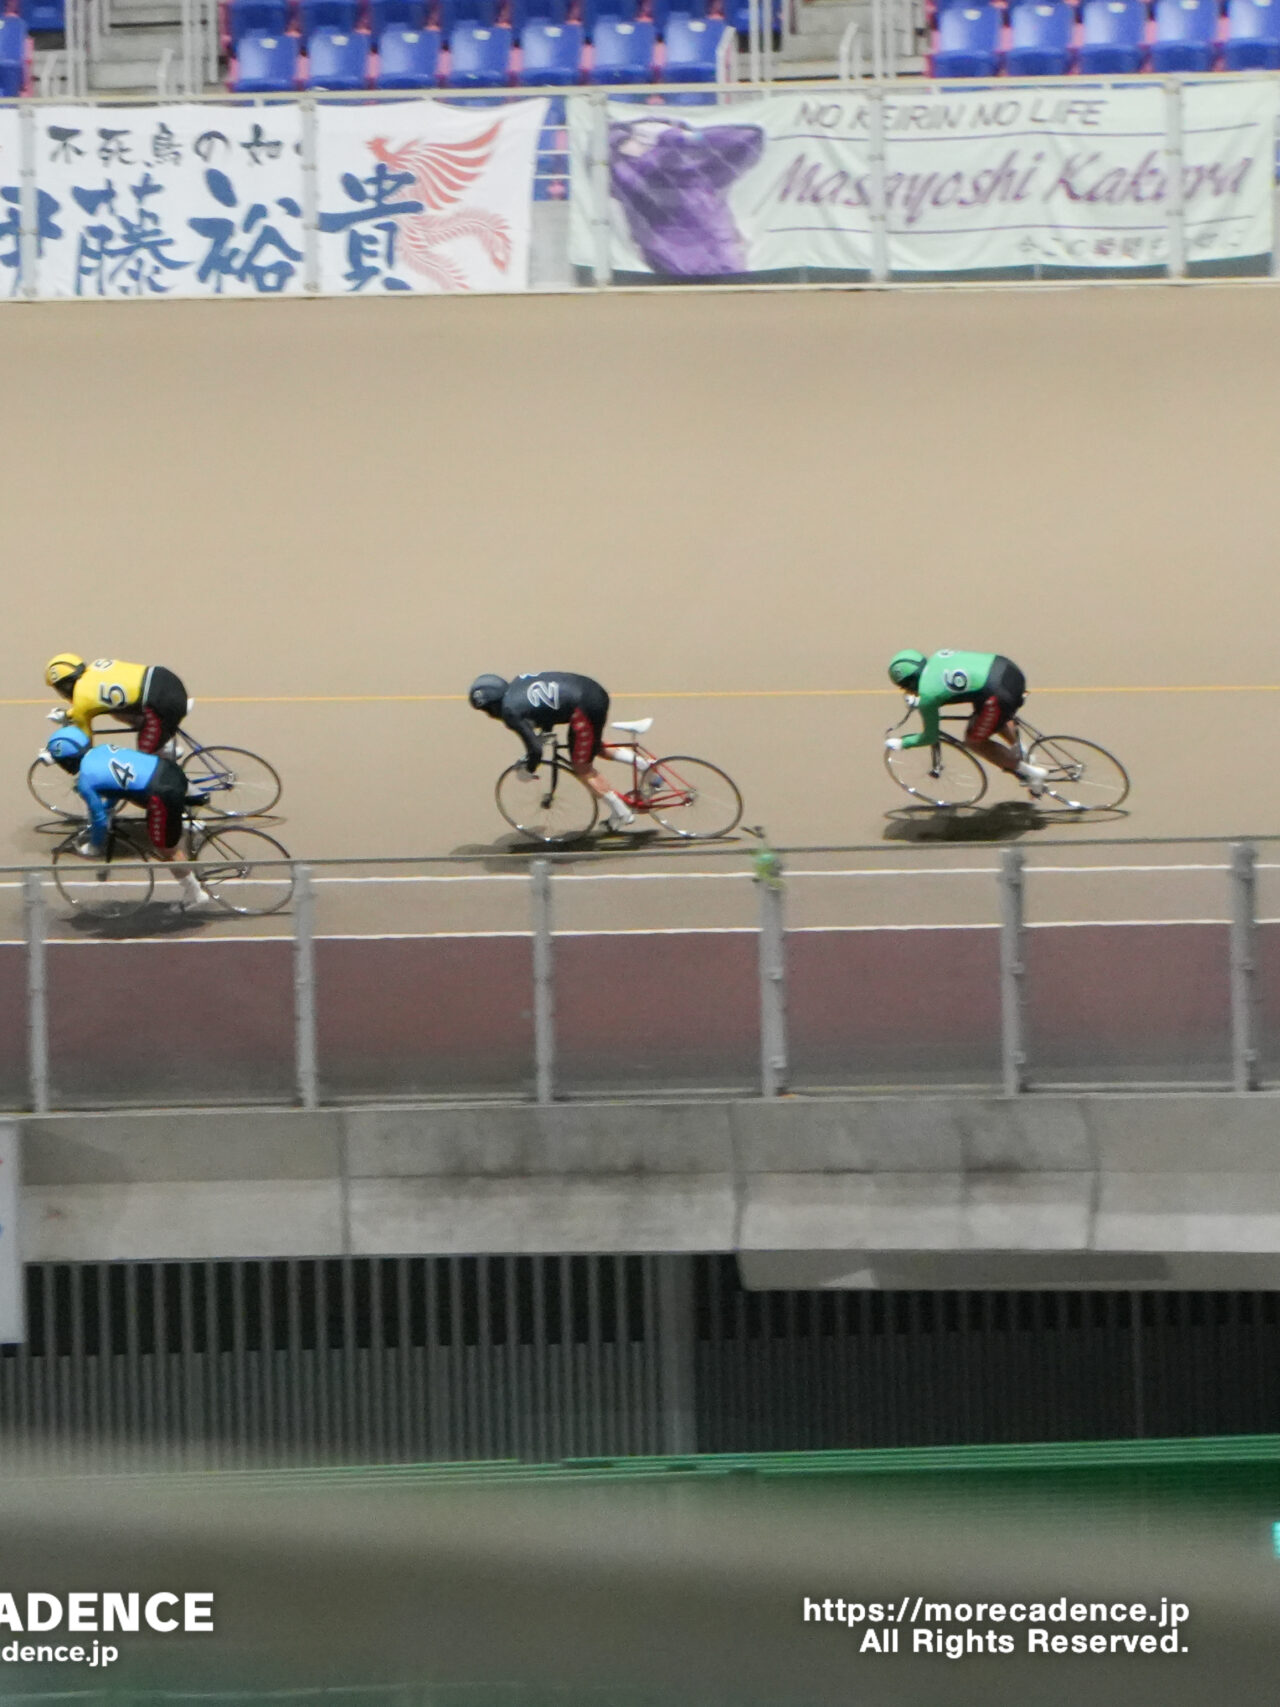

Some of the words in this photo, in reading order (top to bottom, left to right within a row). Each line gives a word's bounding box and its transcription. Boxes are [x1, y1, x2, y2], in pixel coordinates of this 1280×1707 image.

[795, 101, 842, 129] NO
[970, 100, 1021, 127] NO
[1029, 98, 1107, 126] LIFE
[527, 680, 560, 710] 2
[943, 668, 969, 693] 6
[99, 683, 126, 709] 5
[109, 758, 136, 790] 4
